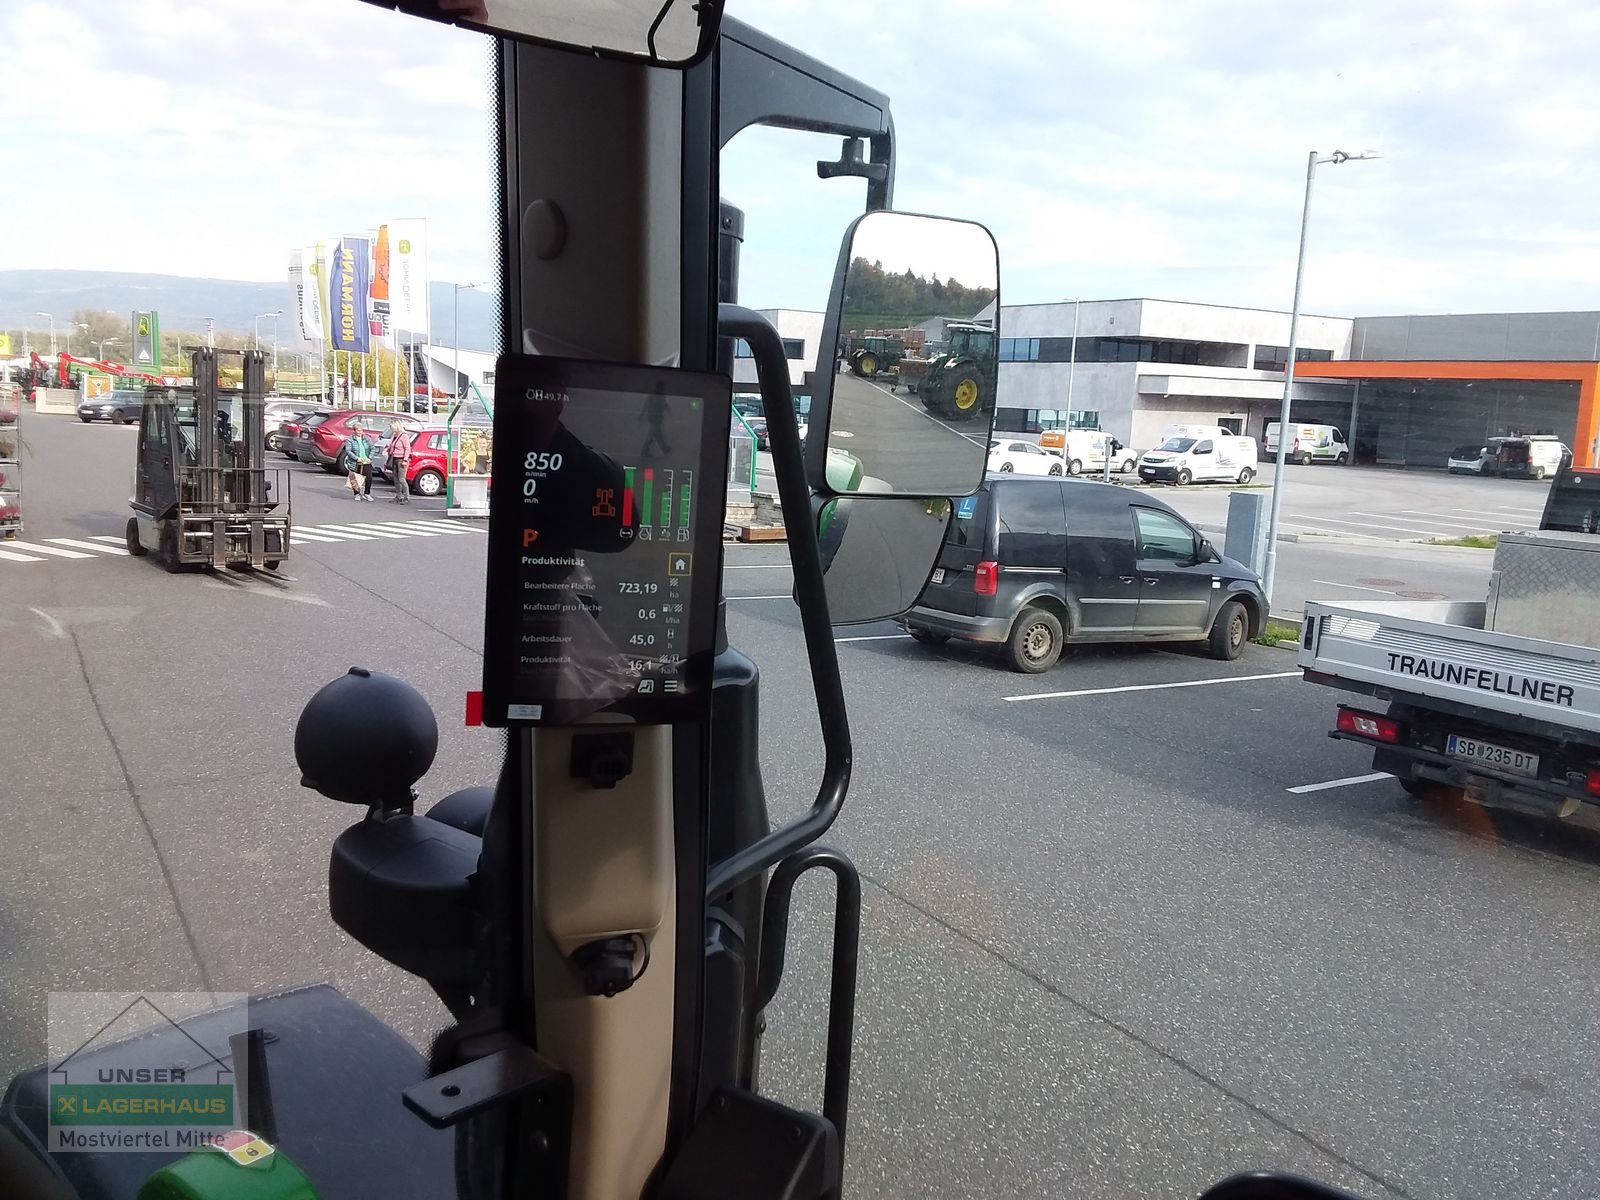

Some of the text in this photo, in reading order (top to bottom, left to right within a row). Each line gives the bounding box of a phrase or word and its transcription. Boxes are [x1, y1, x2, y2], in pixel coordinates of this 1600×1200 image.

[524, 451, 563, 472] 850
[523, 479, 536, 496] 0
[523, 529, 539, 548] P
[521, 556, 585, 567] Produktivität
[524, 582, 569, 590] Bearbeitete
[619, 582, 658, 595] 723,19
[523, 603, 560, 611] Kraftstoff
[562, 605, 577, 613] pro
[638, 609, 656, 621] 0,6
[521, 634, 572, 643] Arbeitsdauer
[629, 634, 655, 647] 45,0
[1388, 652, 1575, 707] TRAUNFELLNER
